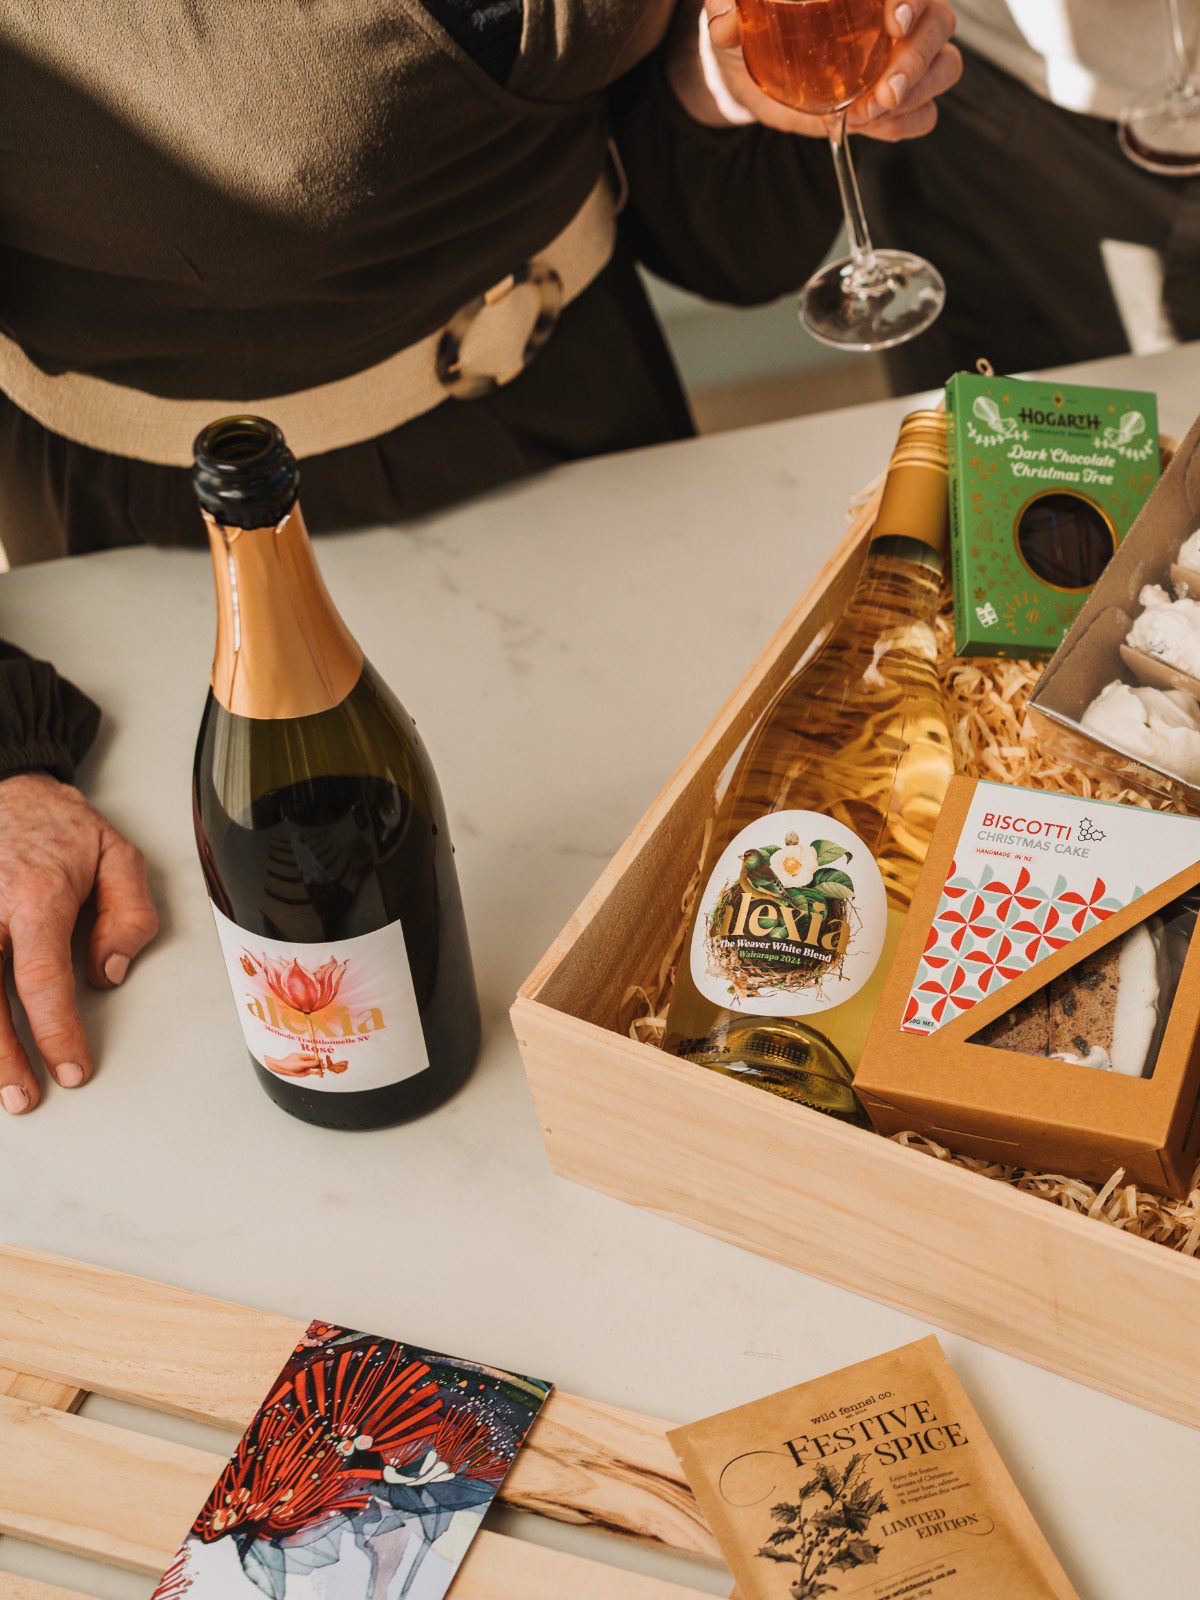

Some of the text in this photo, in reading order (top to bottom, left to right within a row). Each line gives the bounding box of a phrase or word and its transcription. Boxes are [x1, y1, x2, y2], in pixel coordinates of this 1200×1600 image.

[1018, 407, 1102, 430] HOGARTH
[1007, 444, 1116, 468] Dark Chocolate
[1010, 462, 1114, 485] Christmas Tree
[982, 812, 1072, 840] BISCOTTI
[976, 848, 1011, 858] HANDMADE
[977, 830, 1090, 858] CHRISTMAS CAKE
[720, 939, 832, 963] The Weaver White Blend
[739, 950, 801, 965] Wairarapa 2024
[809, 1391, 896, 1425] wild fennel co.
[782, 1400, 937, 1468] FESTIVE
[873, 1422, 969, 1466] SPICE
[881, 1508, 946, 1536] LIMITED
[916, 1513, 980, 1539] EDITION
